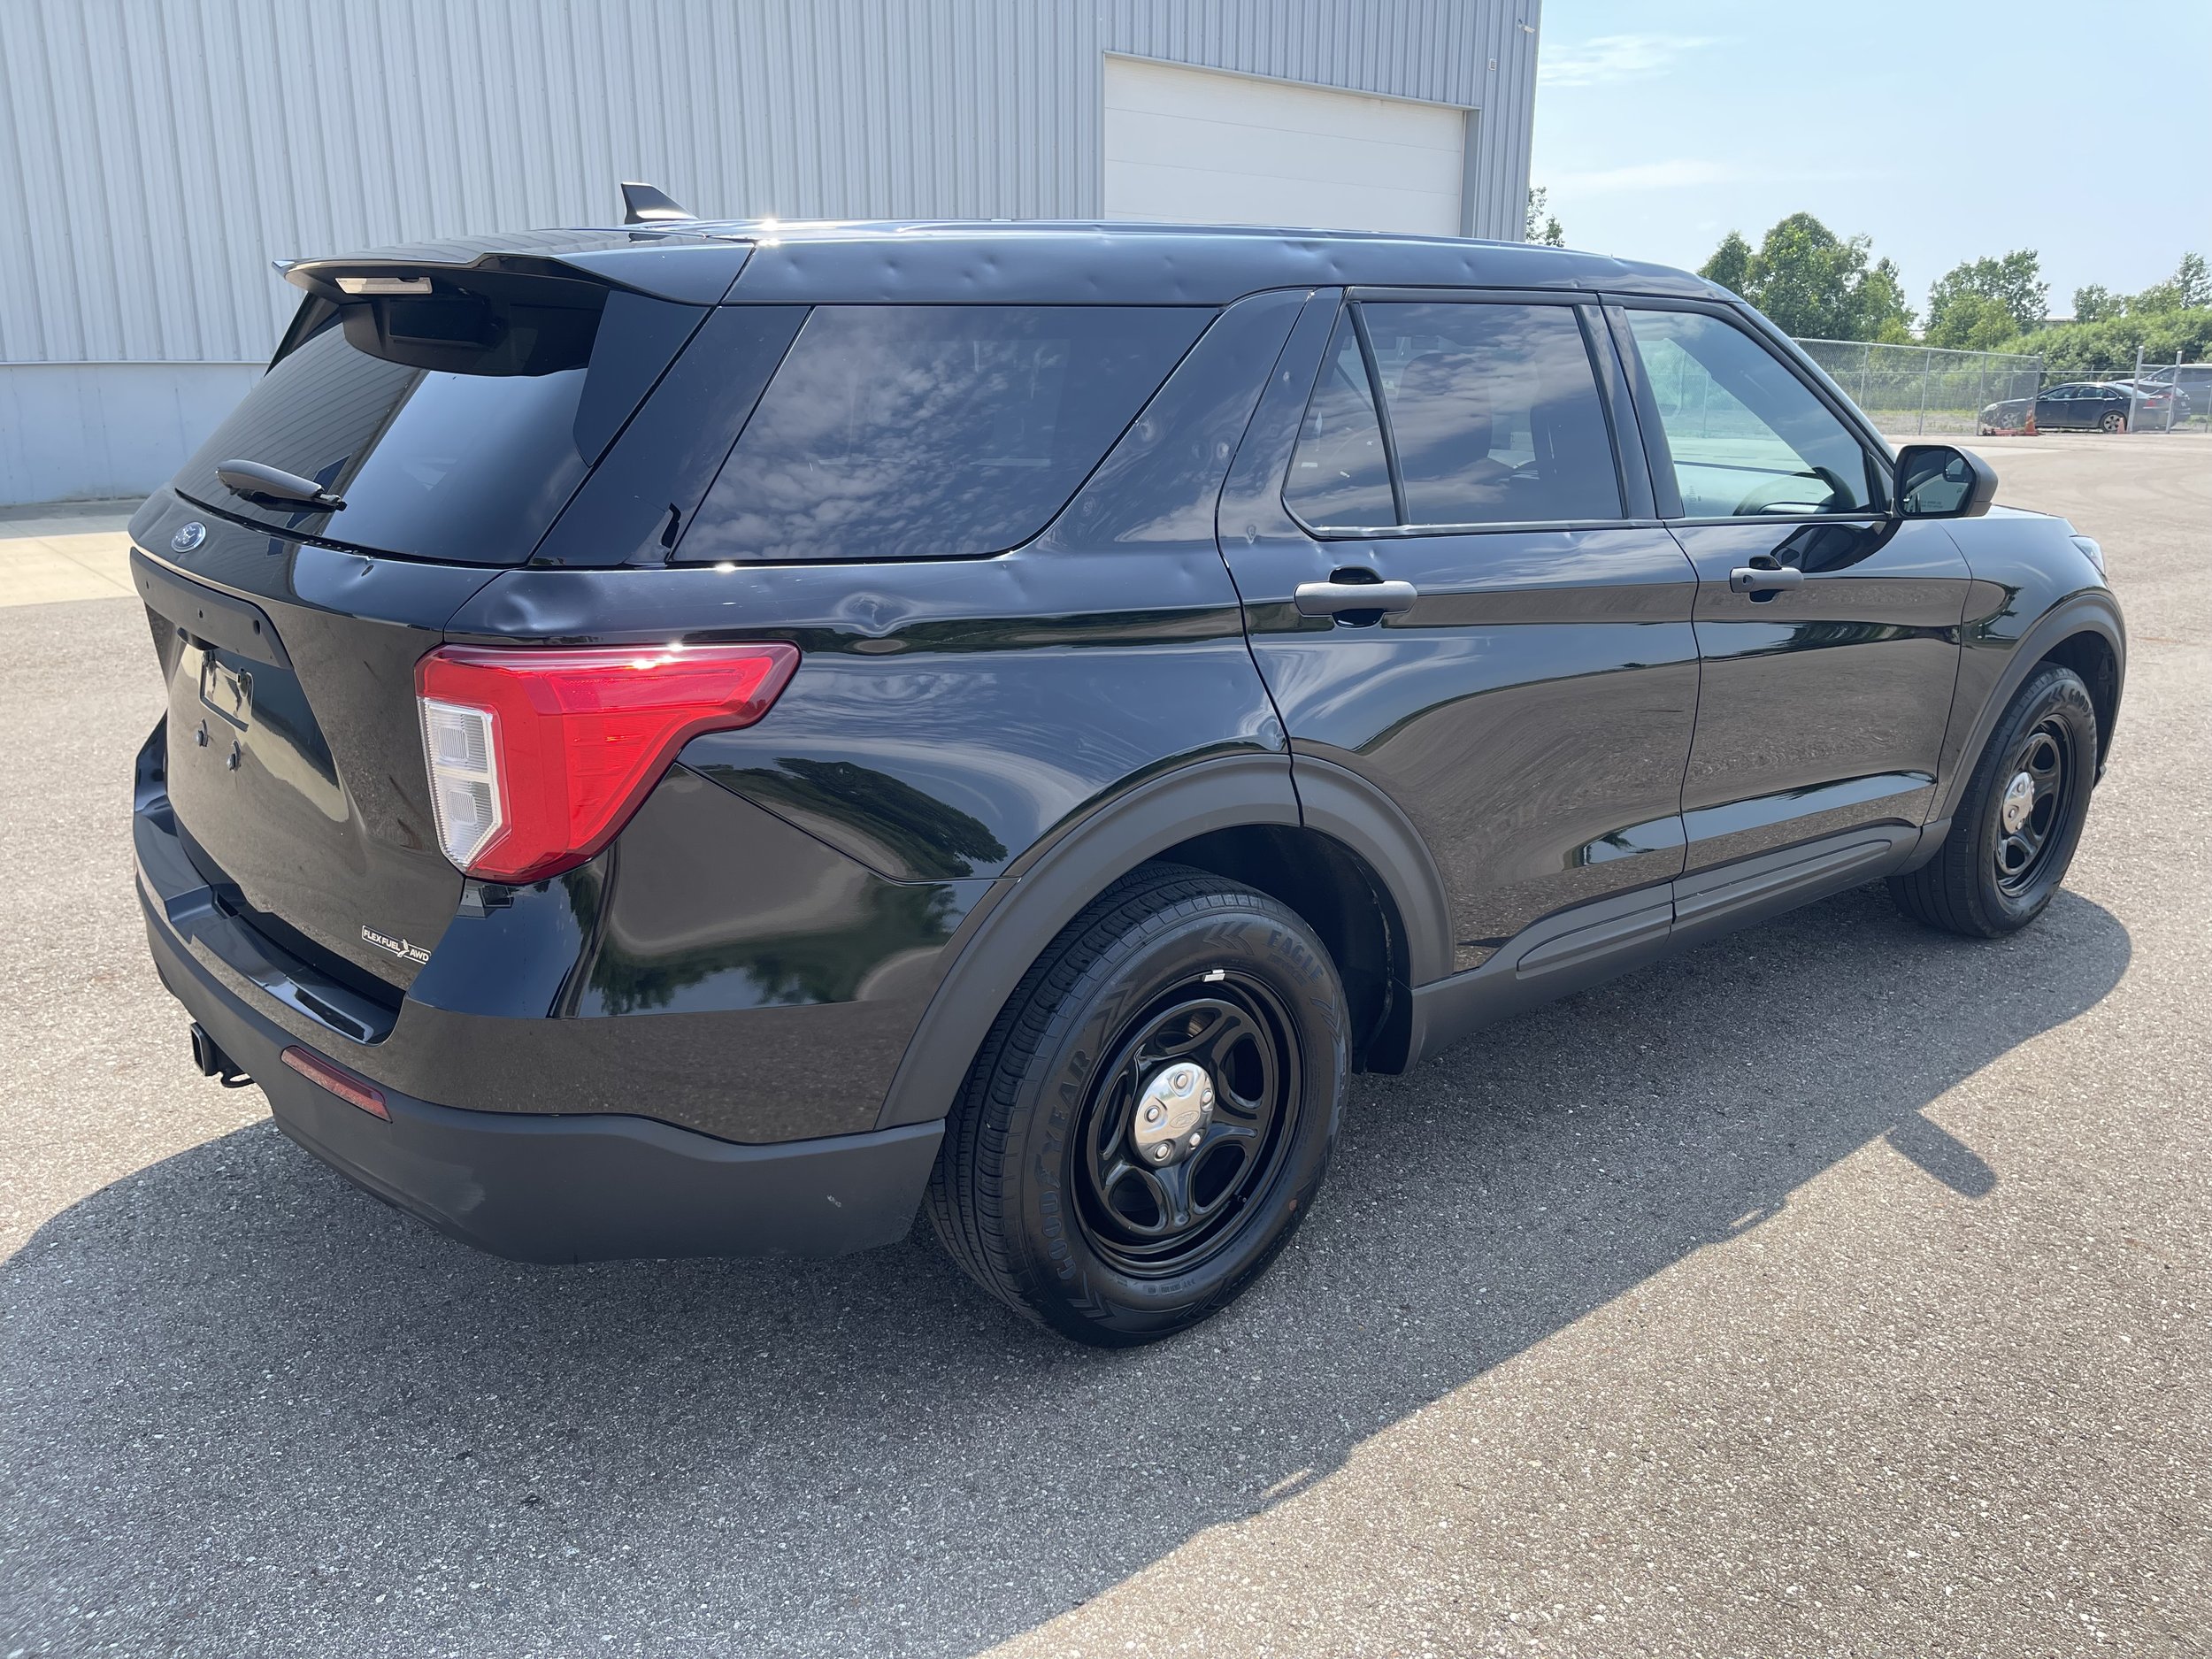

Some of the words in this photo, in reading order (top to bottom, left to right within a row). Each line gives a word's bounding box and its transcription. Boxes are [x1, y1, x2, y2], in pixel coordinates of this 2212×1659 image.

[364, 929, 381, 943] FLEX
[382, 938, 401, 951] FUEL
[410, 949, 429, 962] AWD
[1267, 929, 1324, 984] EAGLE
